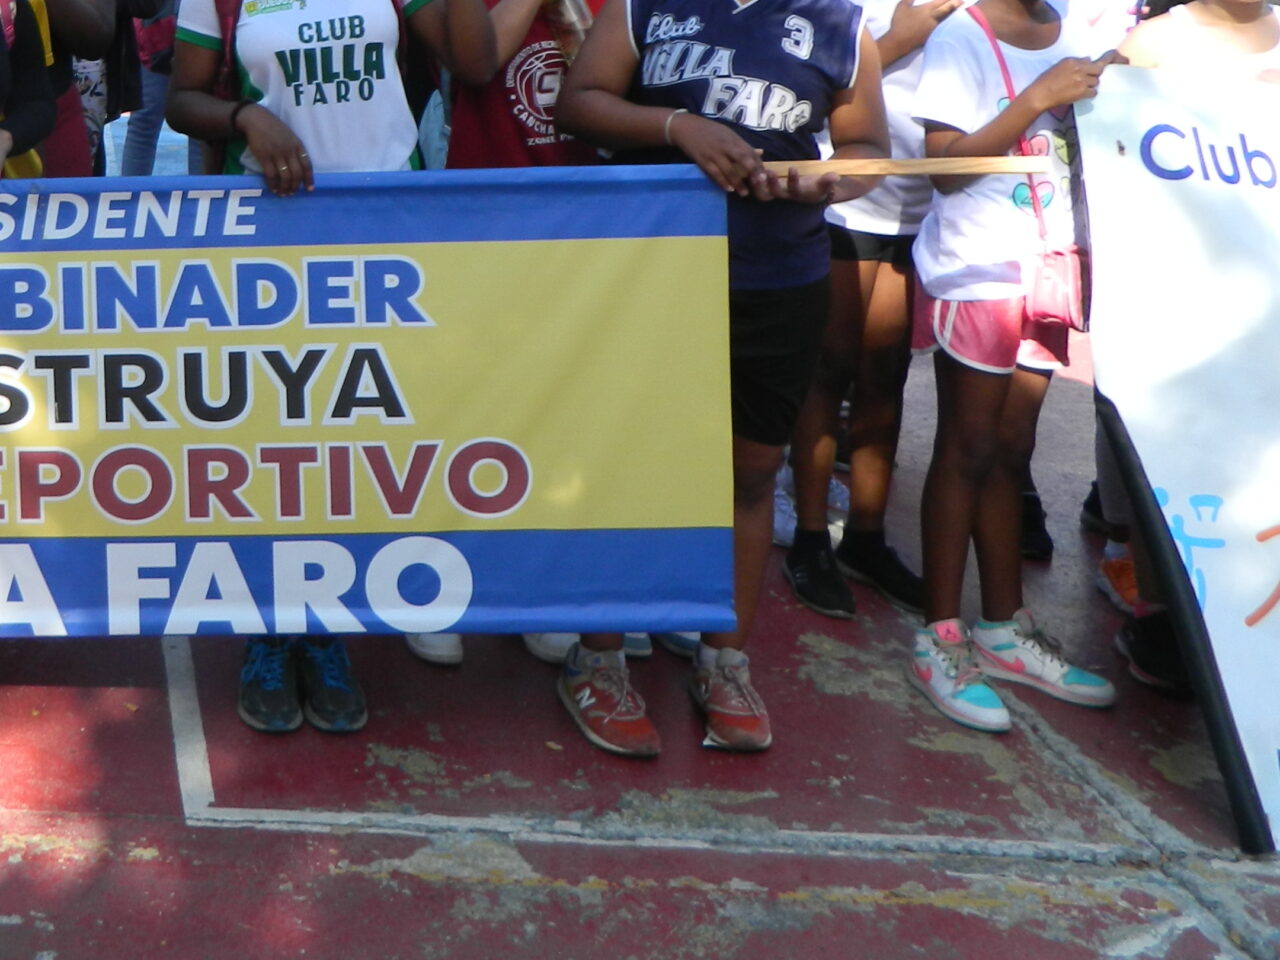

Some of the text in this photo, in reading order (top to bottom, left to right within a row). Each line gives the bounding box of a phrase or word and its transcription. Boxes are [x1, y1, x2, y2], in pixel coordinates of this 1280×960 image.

[298, 14, 365, 44] CLUB
[645, 11, 704, 44] Club
[781, 14, 814, 60] 3
[275, 42, 386, 88] VILLA
[641, 40, 736, 87] VILLA
[293, 77, 375, 107] FARO
[701, 76, 813, 133] FARO
[513, 104, 555, 134] CANCHA
[1140, 123, 1278, 189] Club
[105, 535, 474, 636] FARO
